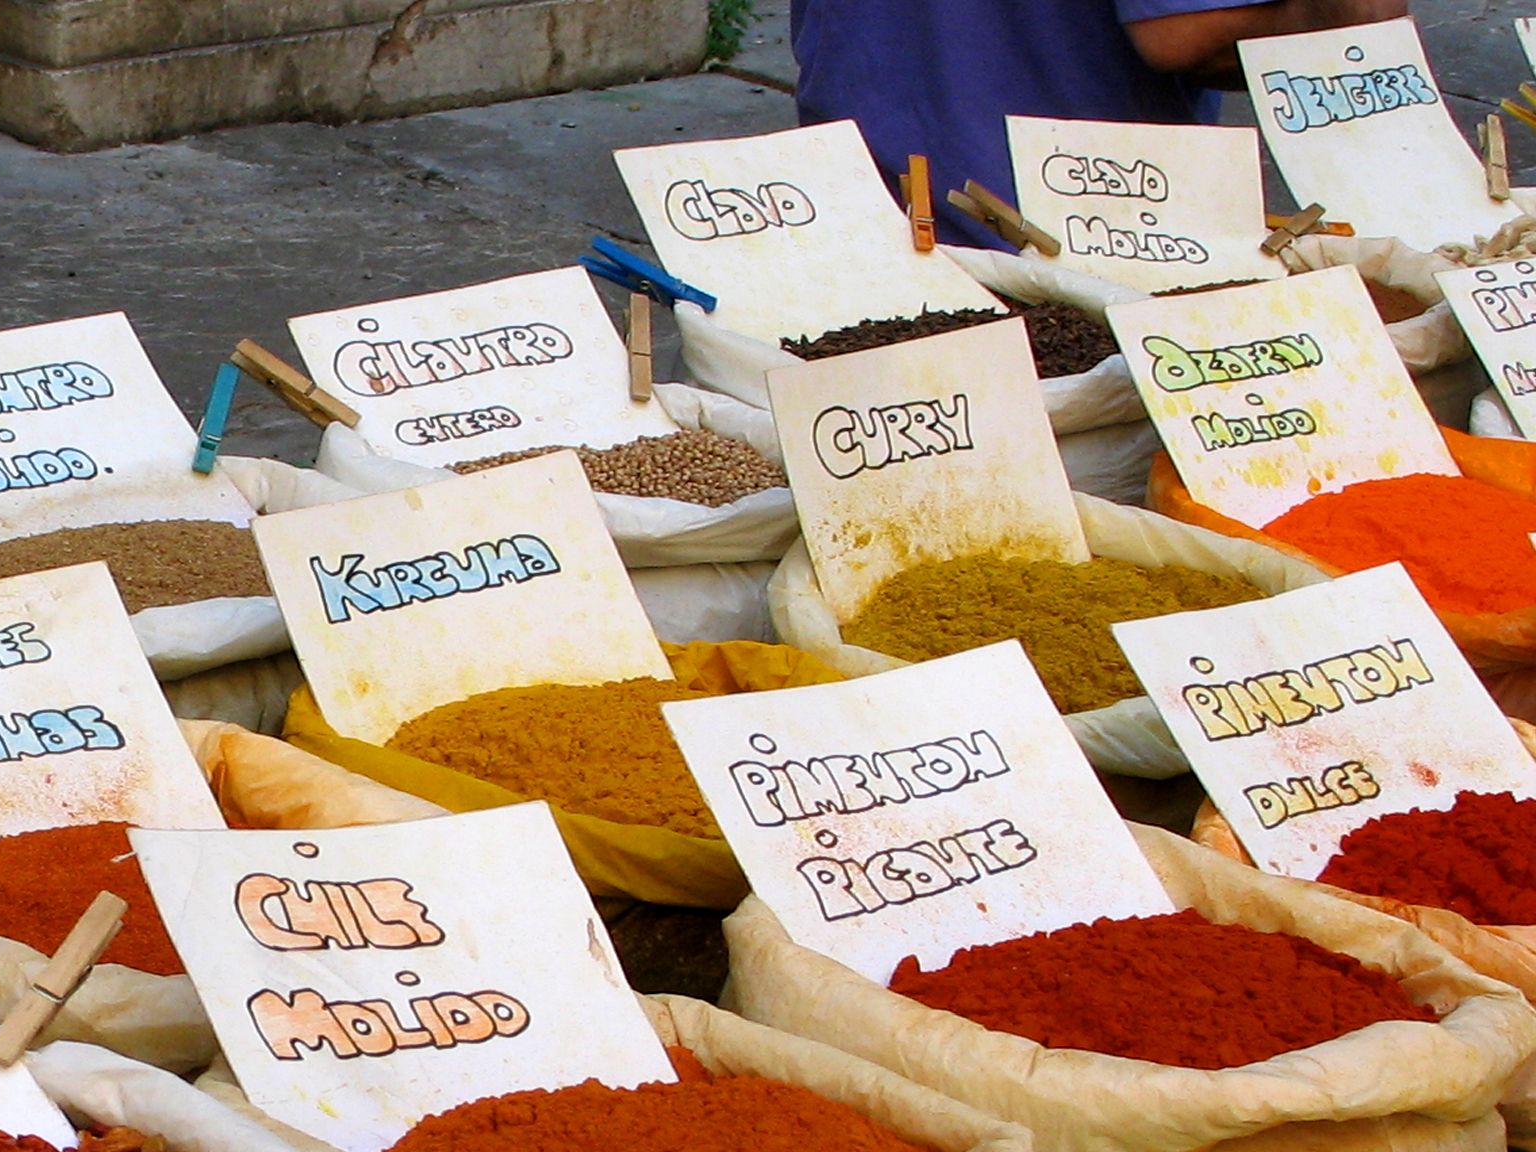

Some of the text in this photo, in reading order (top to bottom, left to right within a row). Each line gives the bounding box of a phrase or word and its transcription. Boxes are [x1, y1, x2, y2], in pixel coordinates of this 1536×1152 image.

[1261, 46, 1439, 133] JENGIBRE
[665, 180, 816, 241] CLAVO
[1066, 212, 1209, 264] MOLIDO
[334, 318, 573, 396] CILANTRO
[395, 405, 521, 445] ENTERO
[813, 395, 974, 478] CURRY
[1191, 393, 1316, 451] MOLIDO
[310, 534, 561, 624] KURCUMA
[1183, 639, 1434, 741] PIMENTON
[729, 730, 1010, 826] PIMENTON
[1243, 761, 1380, 829] DULCE
[235, 842, 445, 951] CHILE
[247, 970, 530, 1060] MOLIDO
